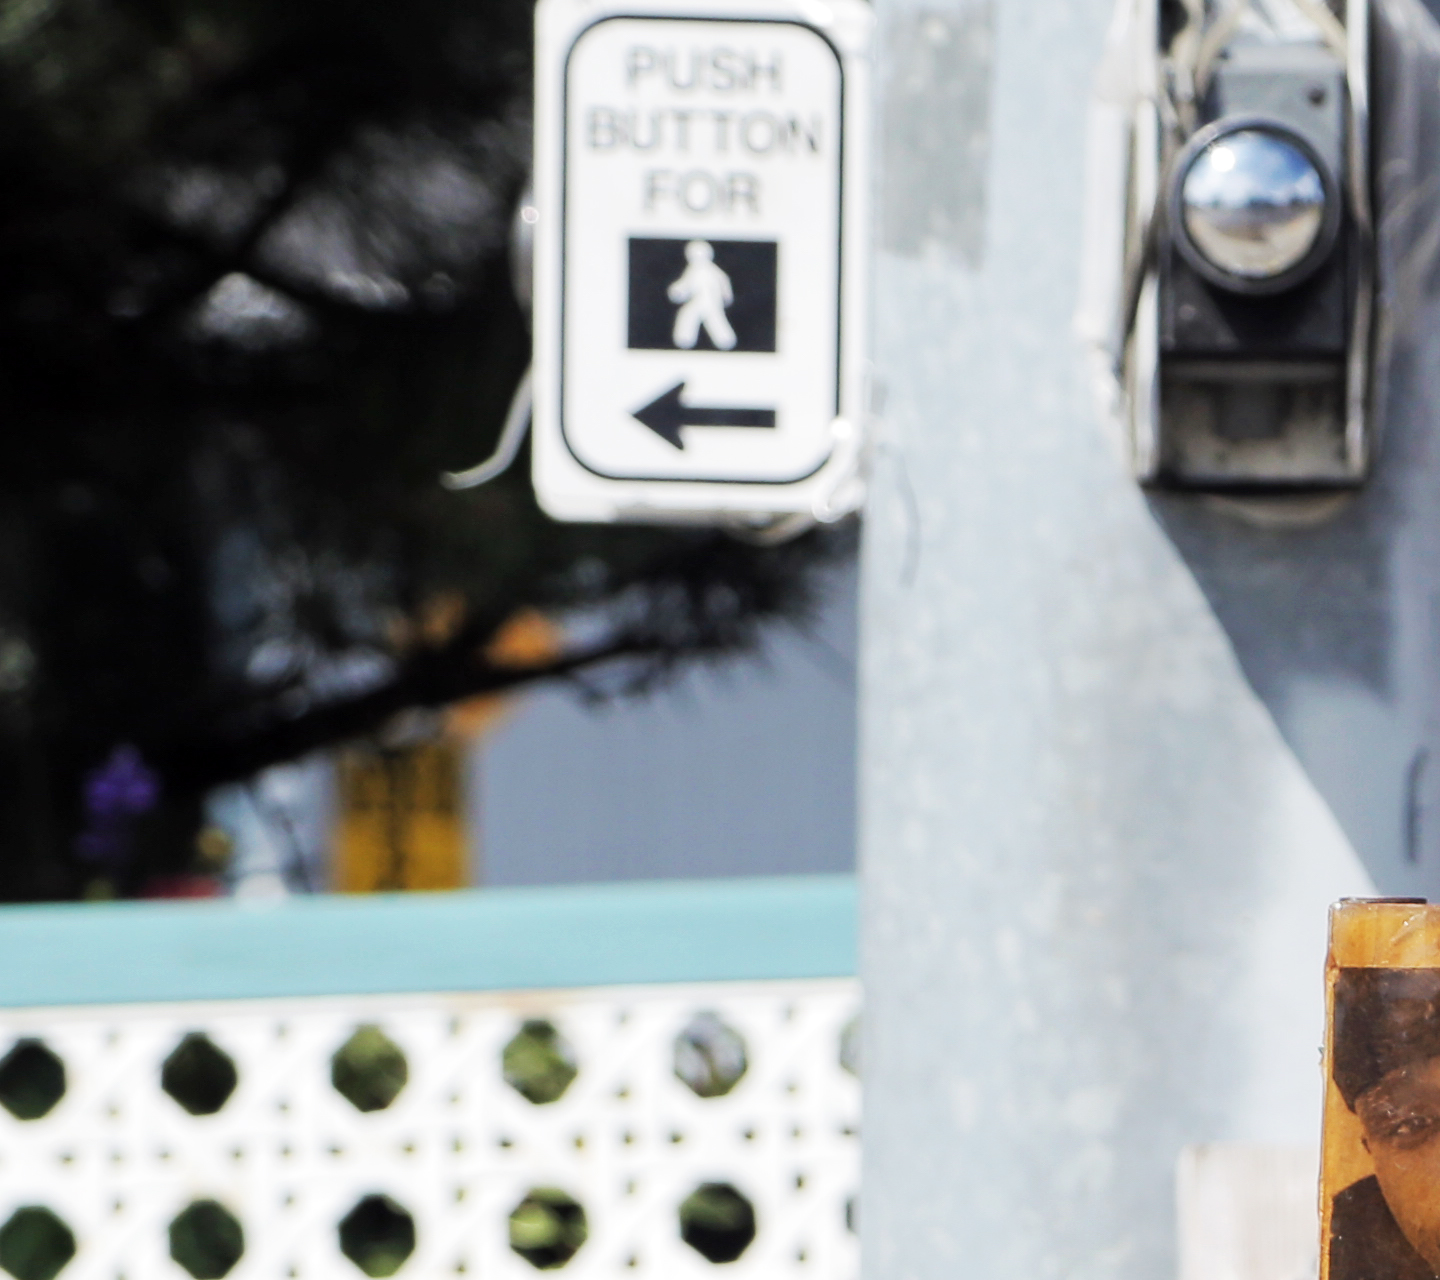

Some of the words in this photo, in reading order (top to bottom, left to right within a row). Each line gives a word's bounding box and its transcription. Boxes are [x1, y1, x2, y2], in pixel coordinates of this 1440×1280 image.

[626, 45, 783, 93] PUSH
[587, 106, 822, 155] BUTTON
[643, 169, 761, 214] FOR
